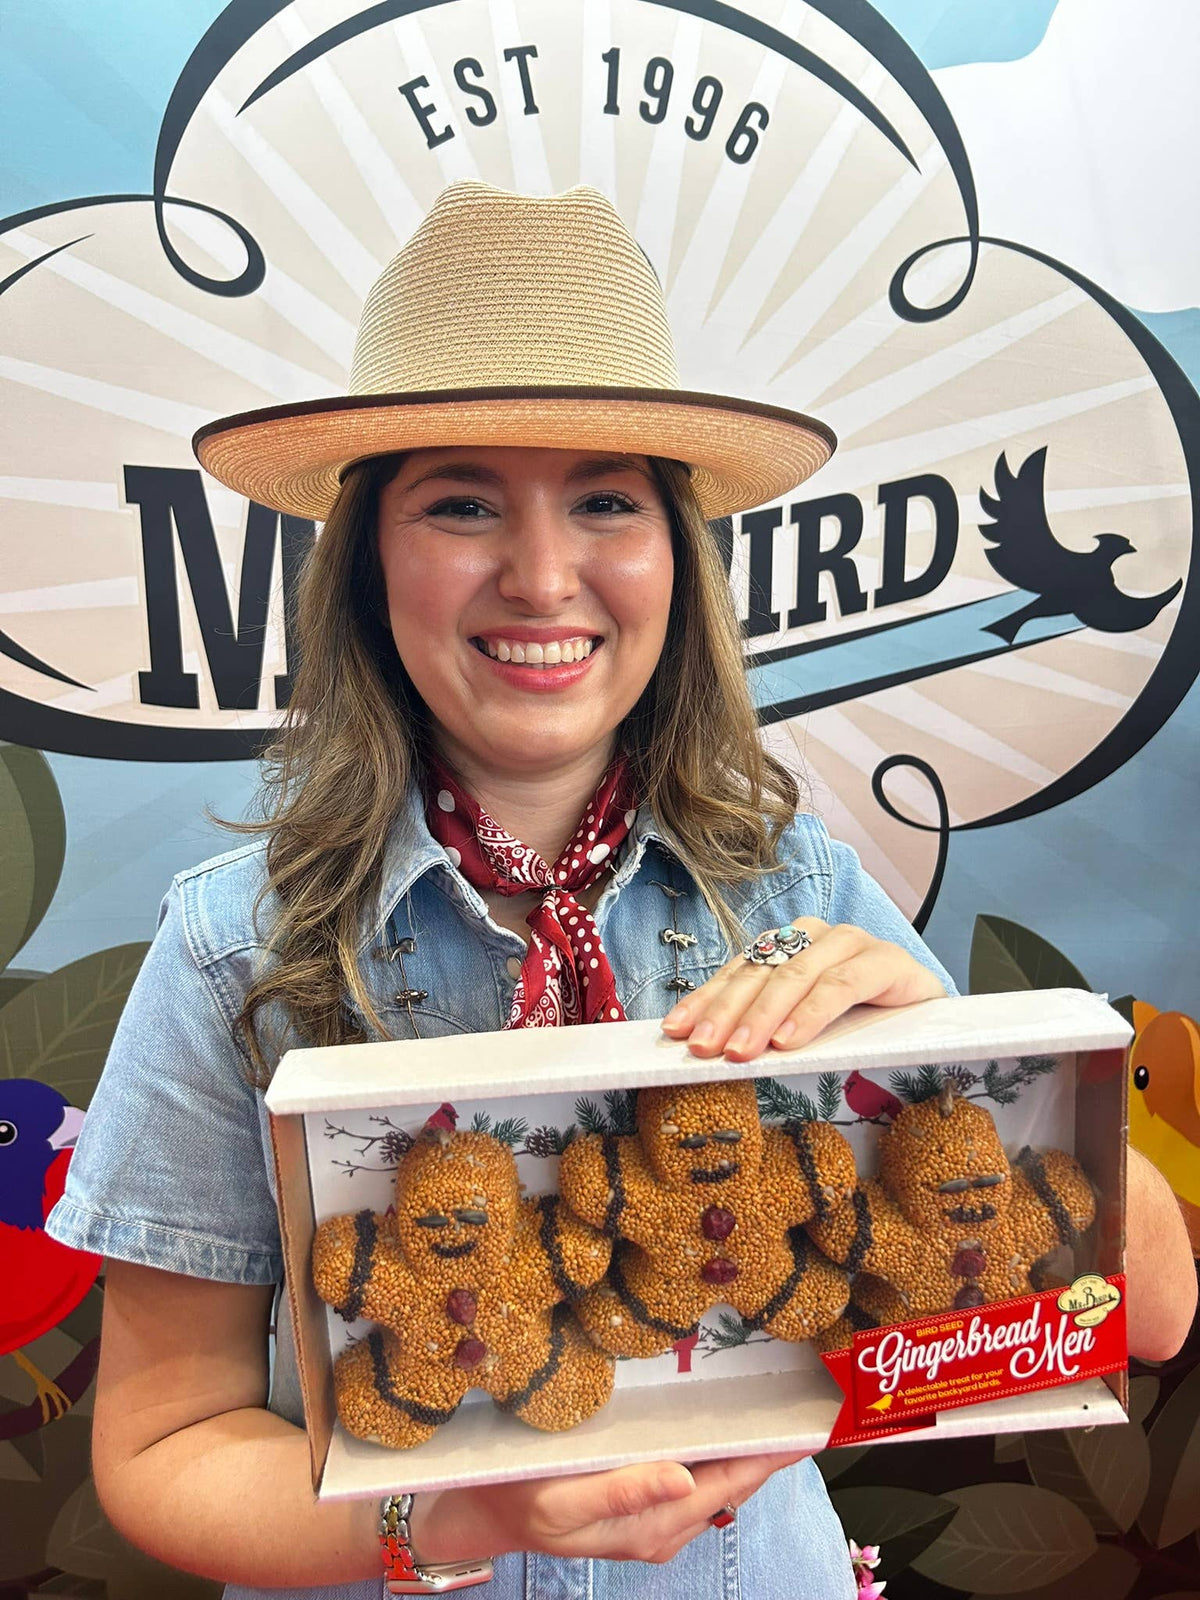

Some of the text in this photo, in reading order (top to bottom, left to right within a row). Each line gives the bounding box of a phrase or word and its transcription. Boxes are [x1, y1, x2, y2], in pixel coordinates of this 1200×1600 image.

[398, 44, 769, 165] EST 1996
[123, 464, 315, 711] M
[858, 1302, 1041, 1393] Gingerbread
[916, 1320, 964, 1337] BIRD SEED
[1009, 1314, 1096, 1378] Men
[904, 1378, 1002, 1405] favorite backyard birds.
[905, 1380, 948, 1395] delectable
[949, 1375, 970, 1386] treat
[971, 1371, 984, 1381] for
[984, 1368, 1004, 1379] your
